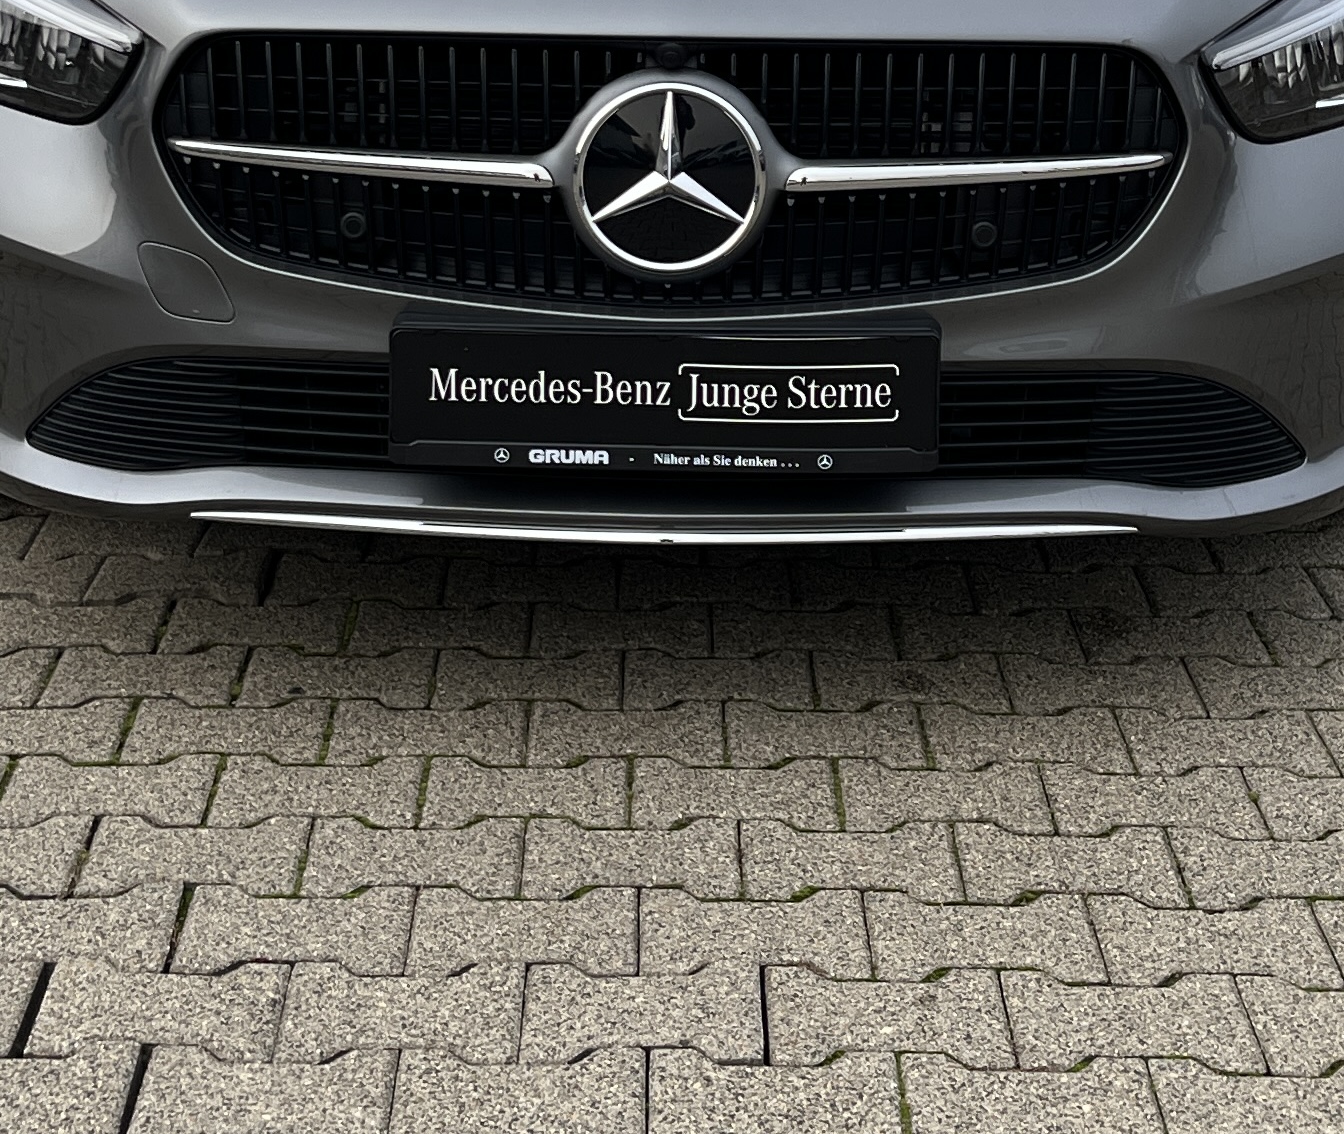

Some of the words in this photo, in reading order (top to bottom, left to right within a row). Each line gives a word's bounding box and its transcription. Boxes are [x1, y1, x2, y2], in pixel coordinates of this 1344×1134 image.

[428, 367, 671, 406] Mercedes-Benz
[686, 373, 778, 416] Junge
[787, 375, 892, 409] Sterne
[528, 448, 610, 465] GRUMA
[653, 452, 691, 465] Näher
[693, 454, 710, 466] als
[712, 454, 732, 466] Sie
[734, 455, 778, 468] denken
